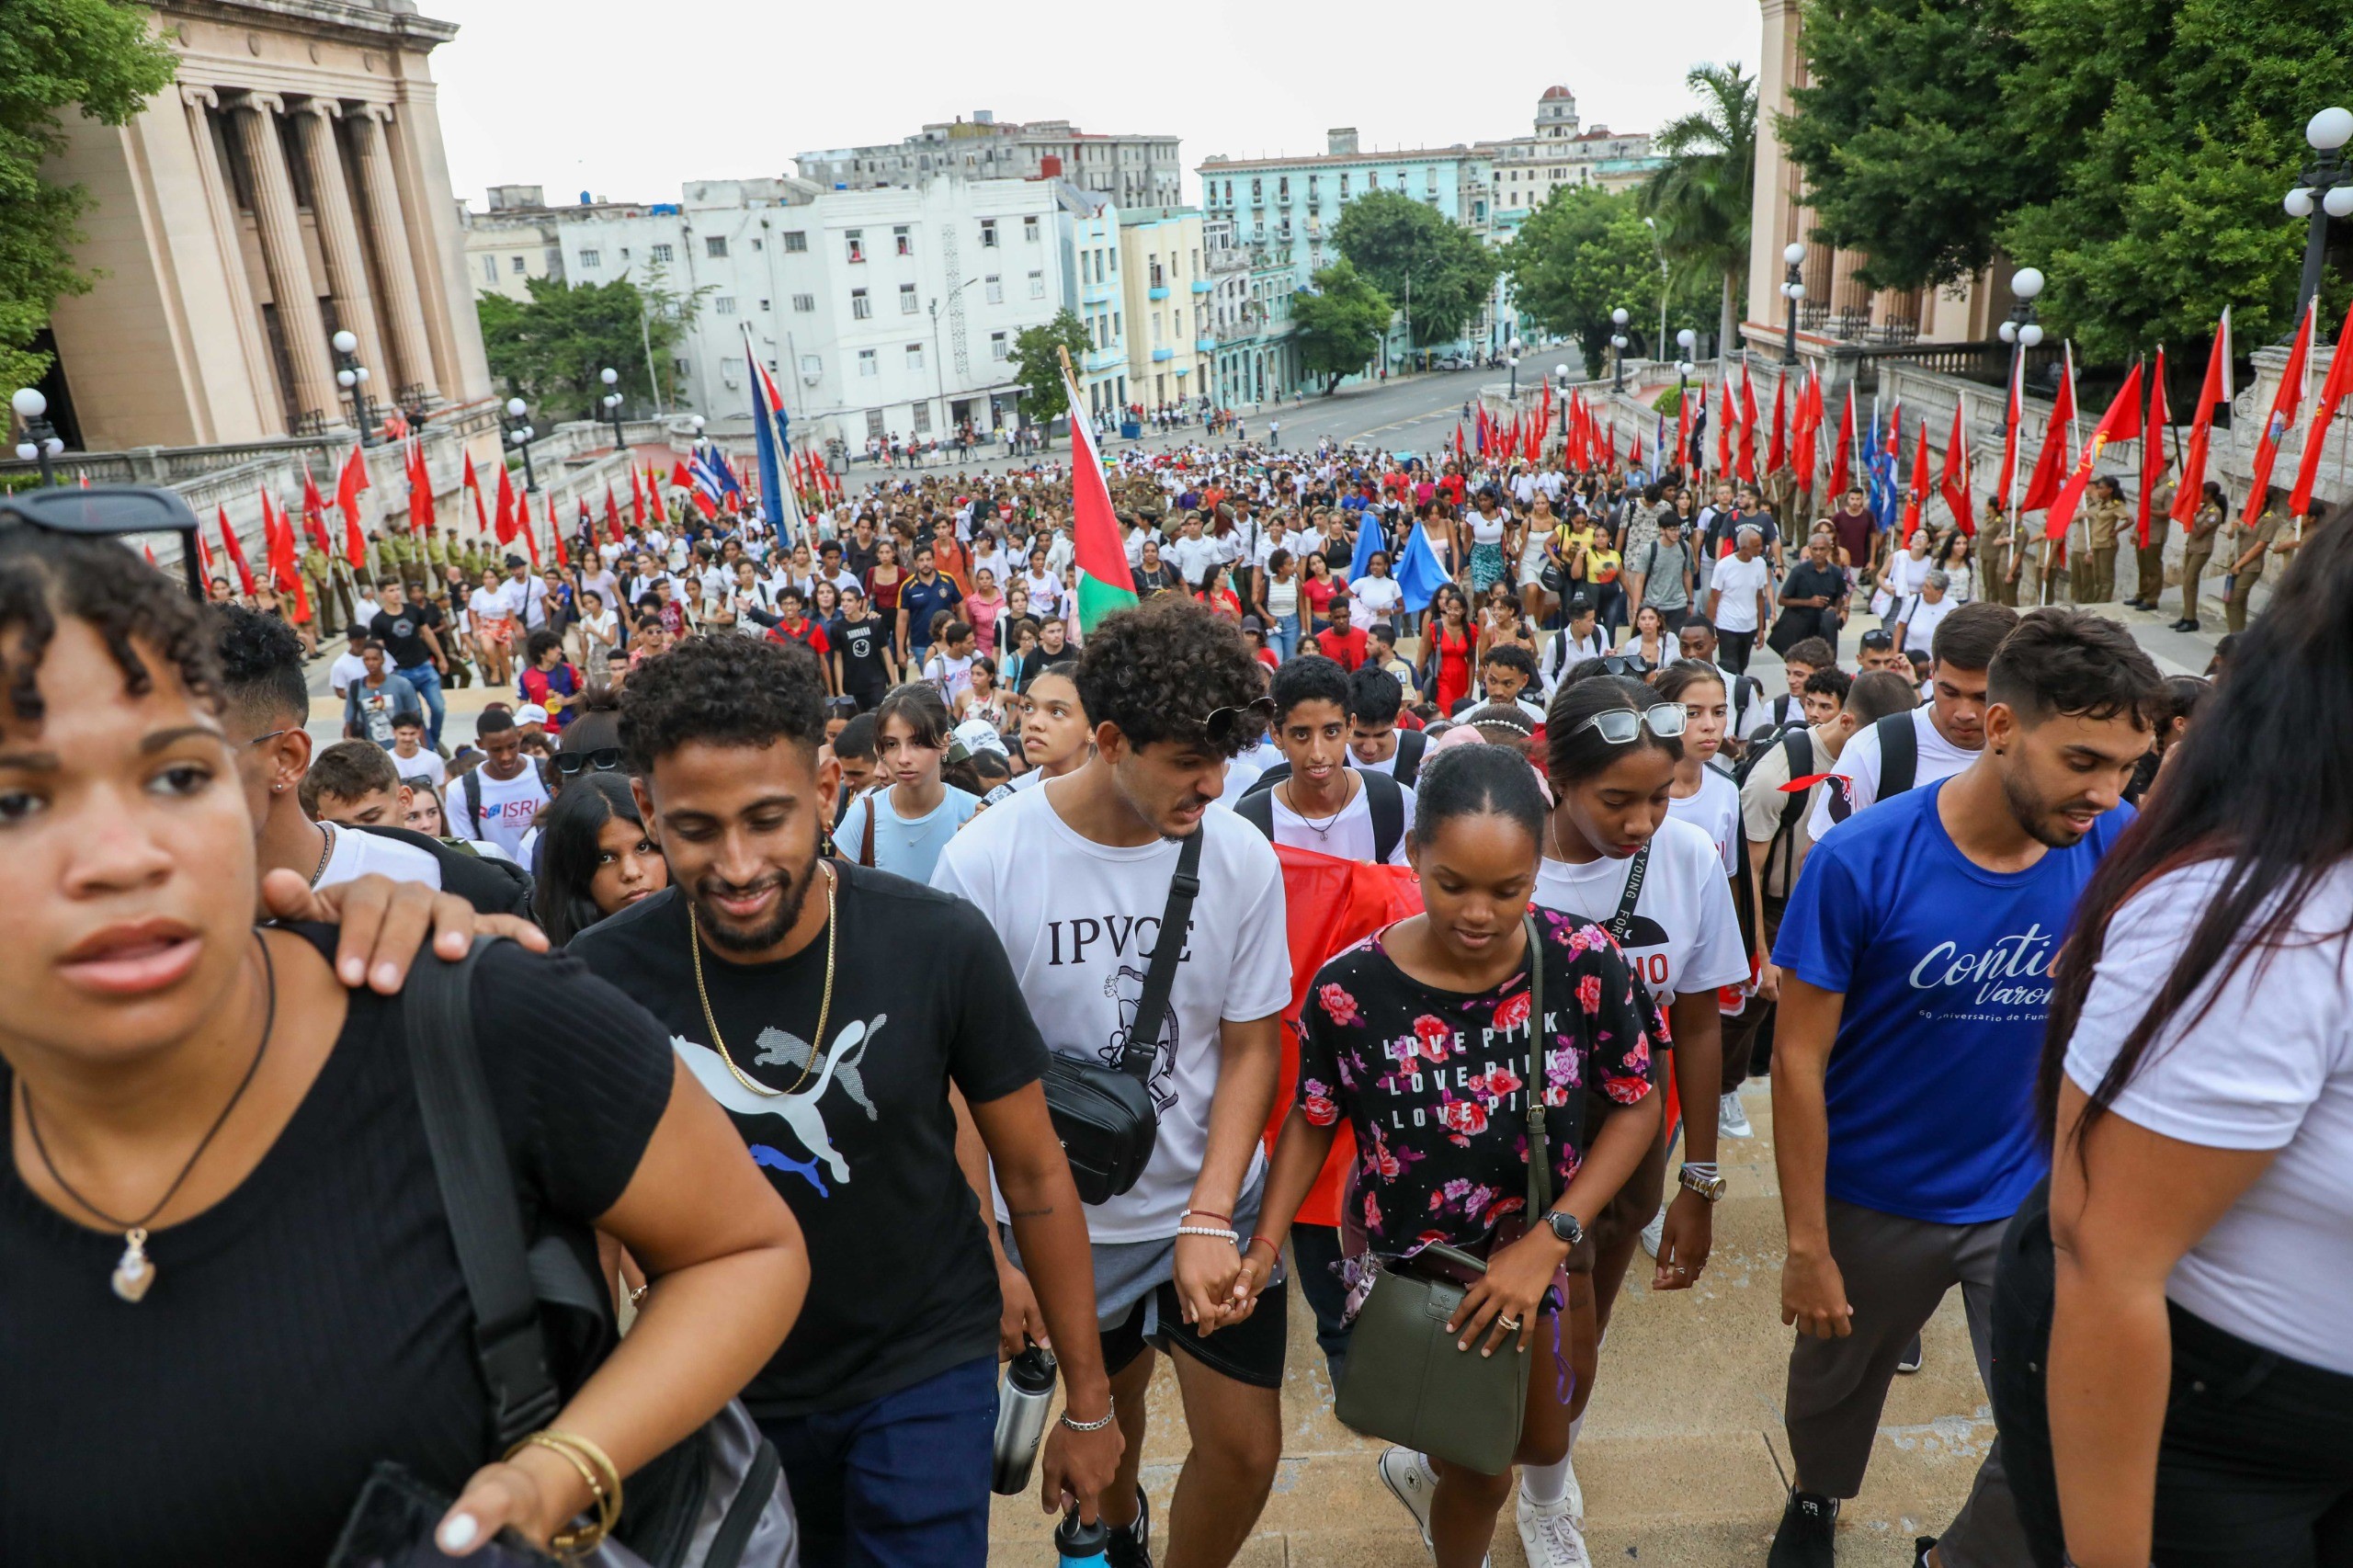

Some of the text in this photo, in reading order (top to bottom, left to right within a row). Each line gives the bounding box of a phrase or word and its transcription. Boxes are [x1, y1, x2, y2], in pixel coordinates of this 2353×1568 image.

[503, 798, 539, 818] ISRI
[1625, 858, 1645, 900] YOUNG
[1909, 923, 2059, 989] Conti
[2006, 1013, 2019, 1021] de
[1383, 1031, 1466, 1060] LOVE
[1389, 1066, 1469, 1096] LOVE
[1392, 1085, 1560, 1129] LOVE PIK
